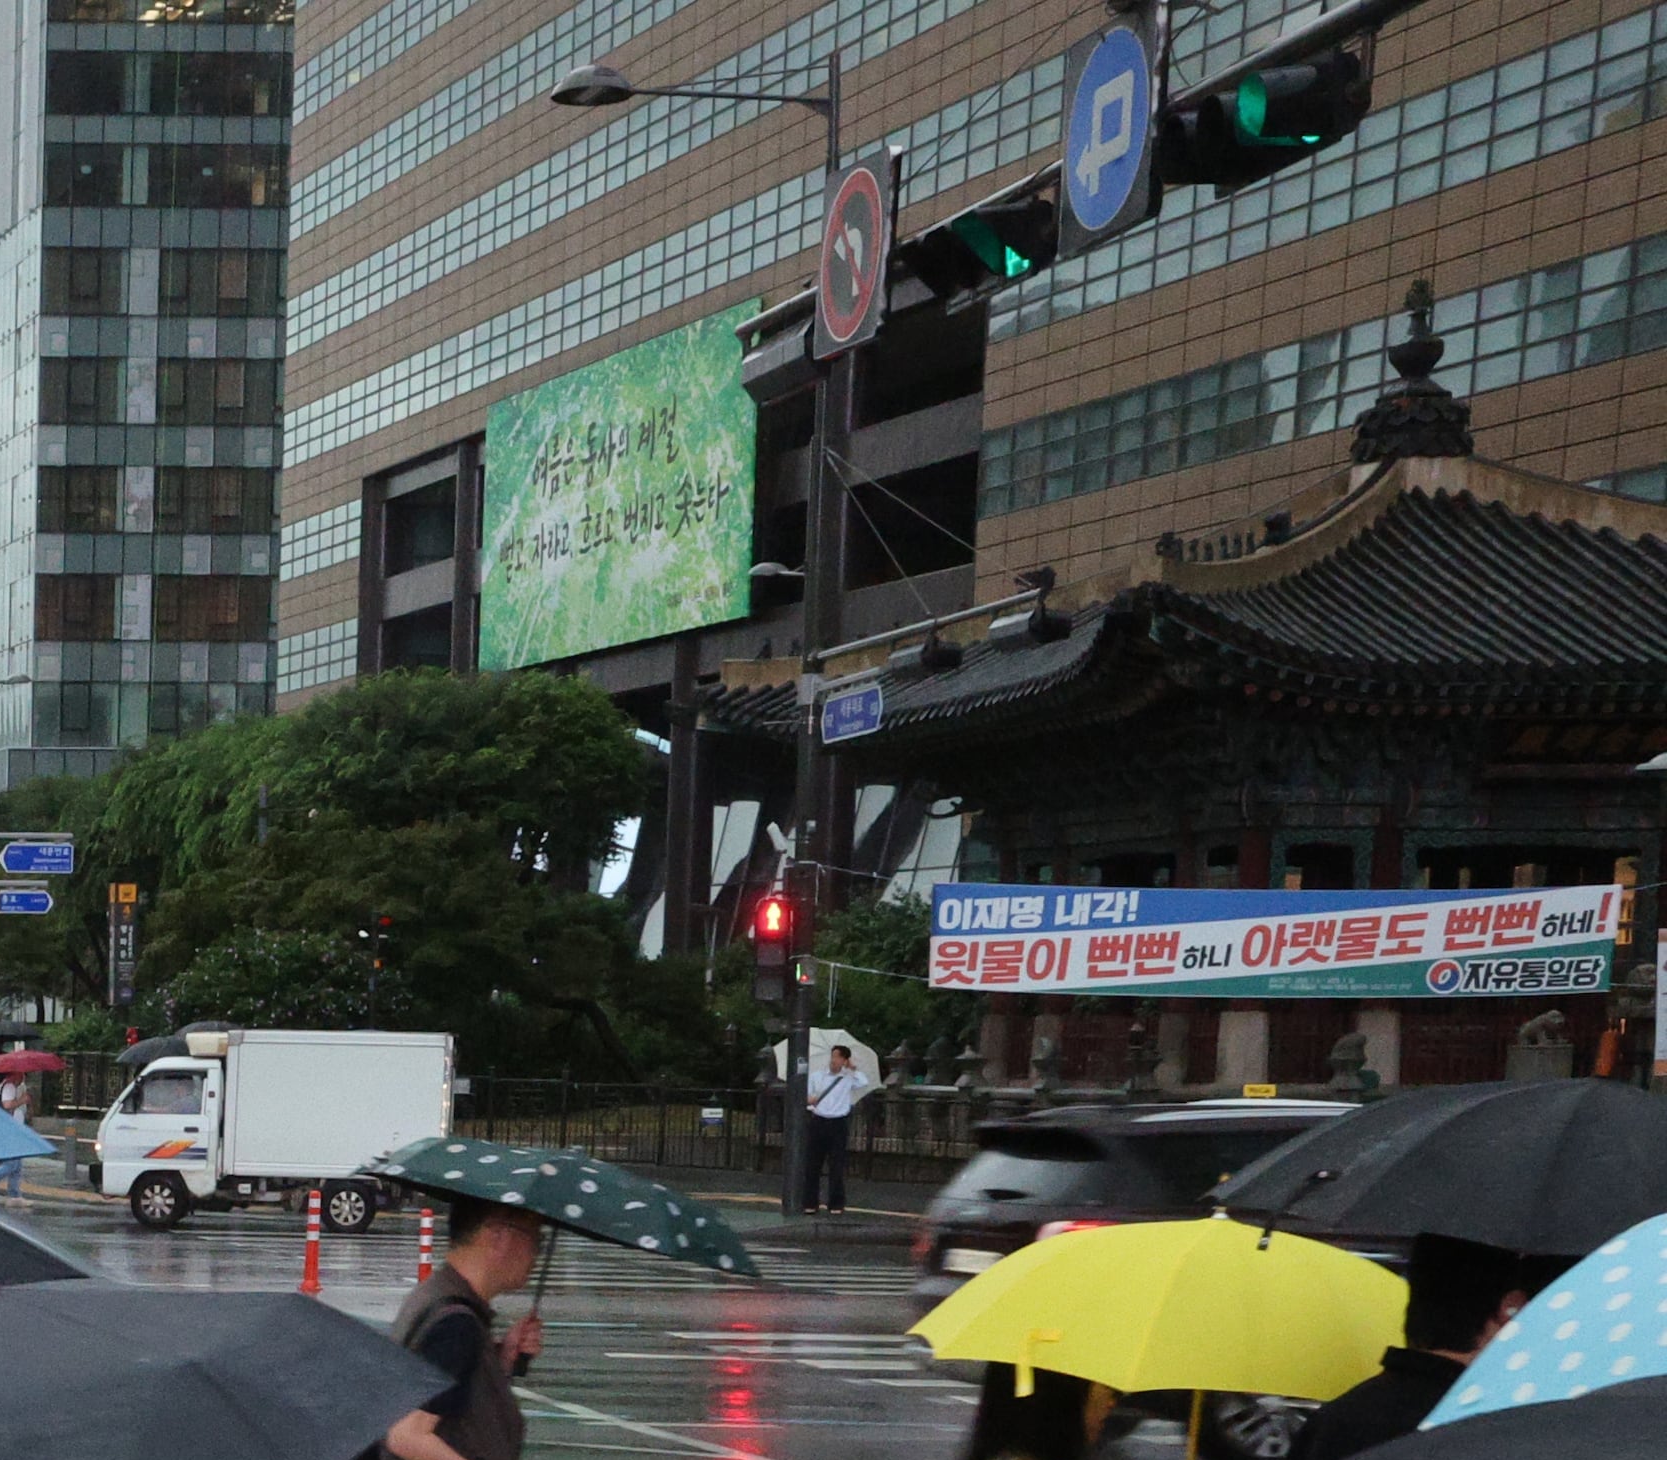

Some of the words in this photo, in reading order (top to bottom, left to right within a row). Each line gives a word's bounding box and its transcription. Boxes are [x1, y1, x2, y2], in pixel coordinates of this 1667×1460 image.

[533, 433, 575, 499] 여름은
[581, 422, 630, 488] 동사의
[637, 394, 680, 463] 계절
[673, 472, 730, 537] 솟는다
[938, 896, 1045, 930] 이재명
[1054, 890, 1140, 926] 내각!
[934, 937, 1072, 985] 윗물이
[1241, 912, 1428, 967] 아랫물도
[1465, 957, 1603, 990] 자유통일당
